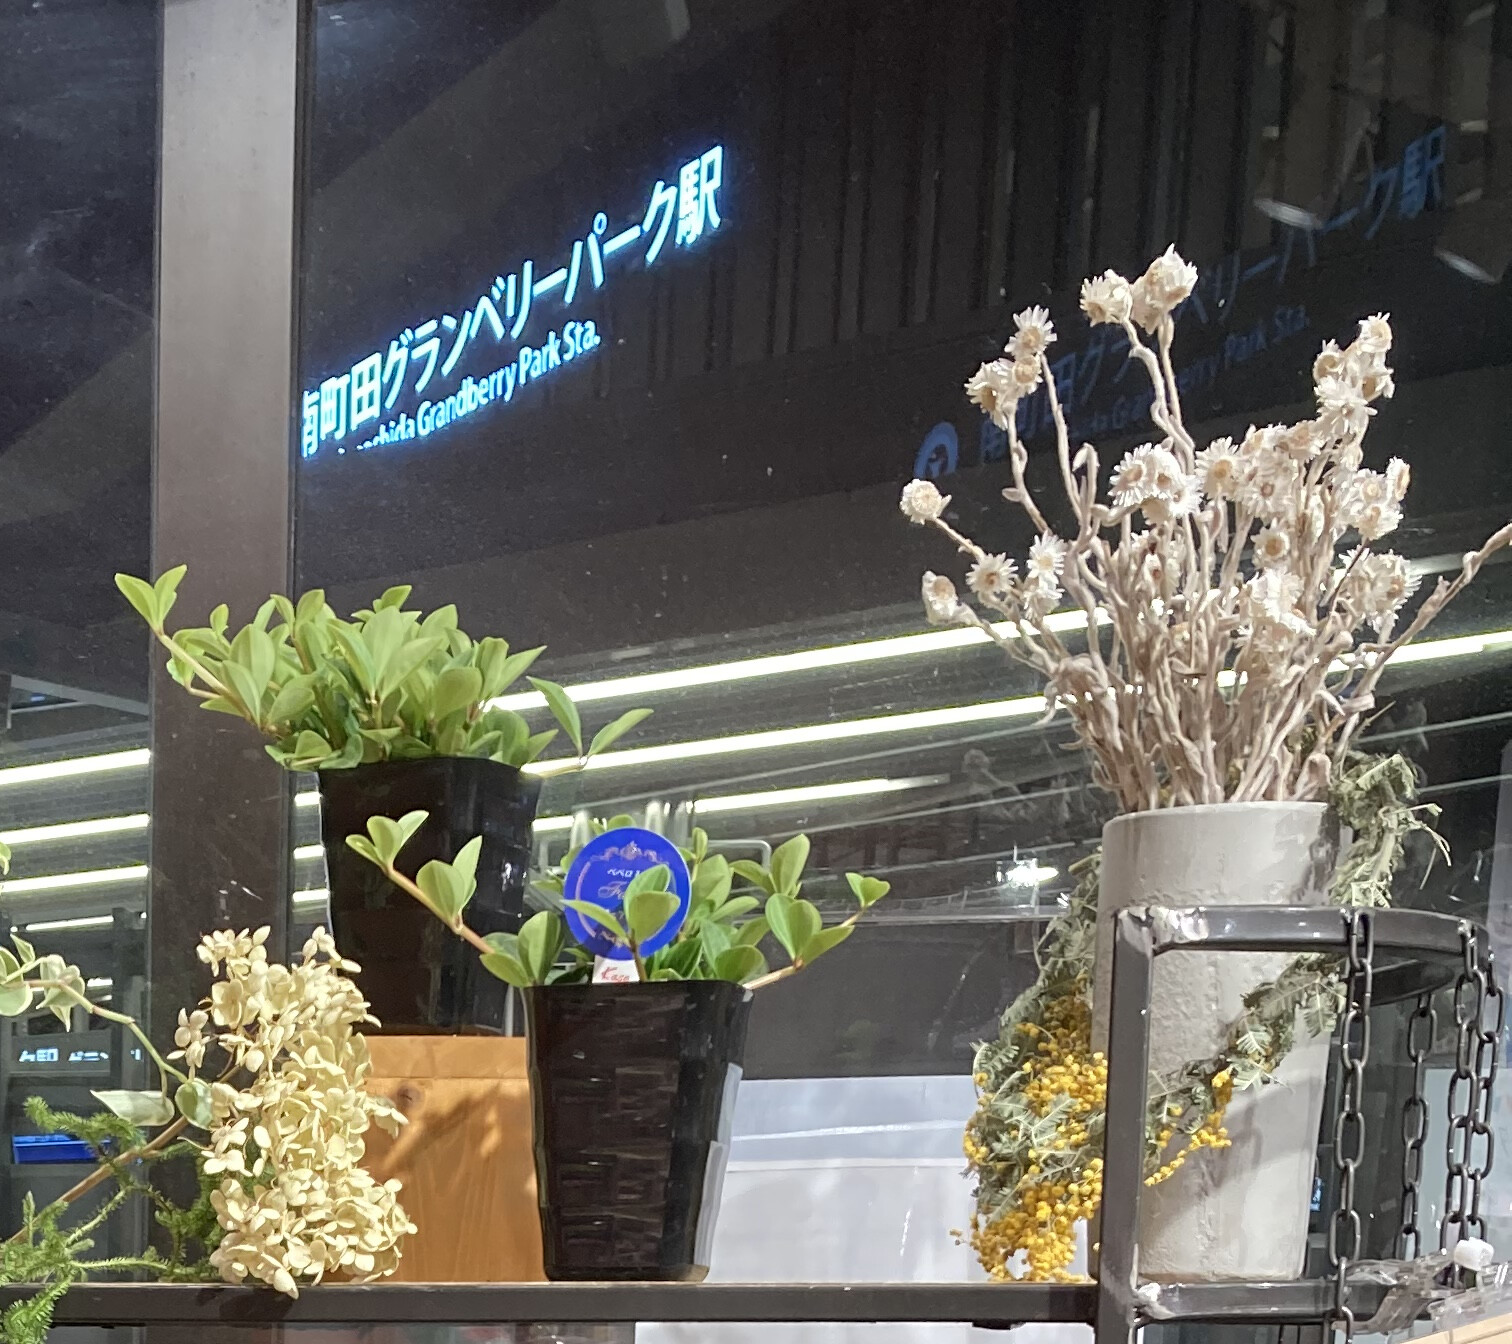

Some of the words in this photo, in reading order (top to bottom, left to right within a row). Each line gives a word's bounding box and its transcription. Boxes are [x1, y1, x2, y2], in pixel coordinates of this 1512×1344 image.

[417, 362, 518, 437] Grandberry
[519, 333, 561, 386] Park
[563, 320, 601, 360] Sta.
